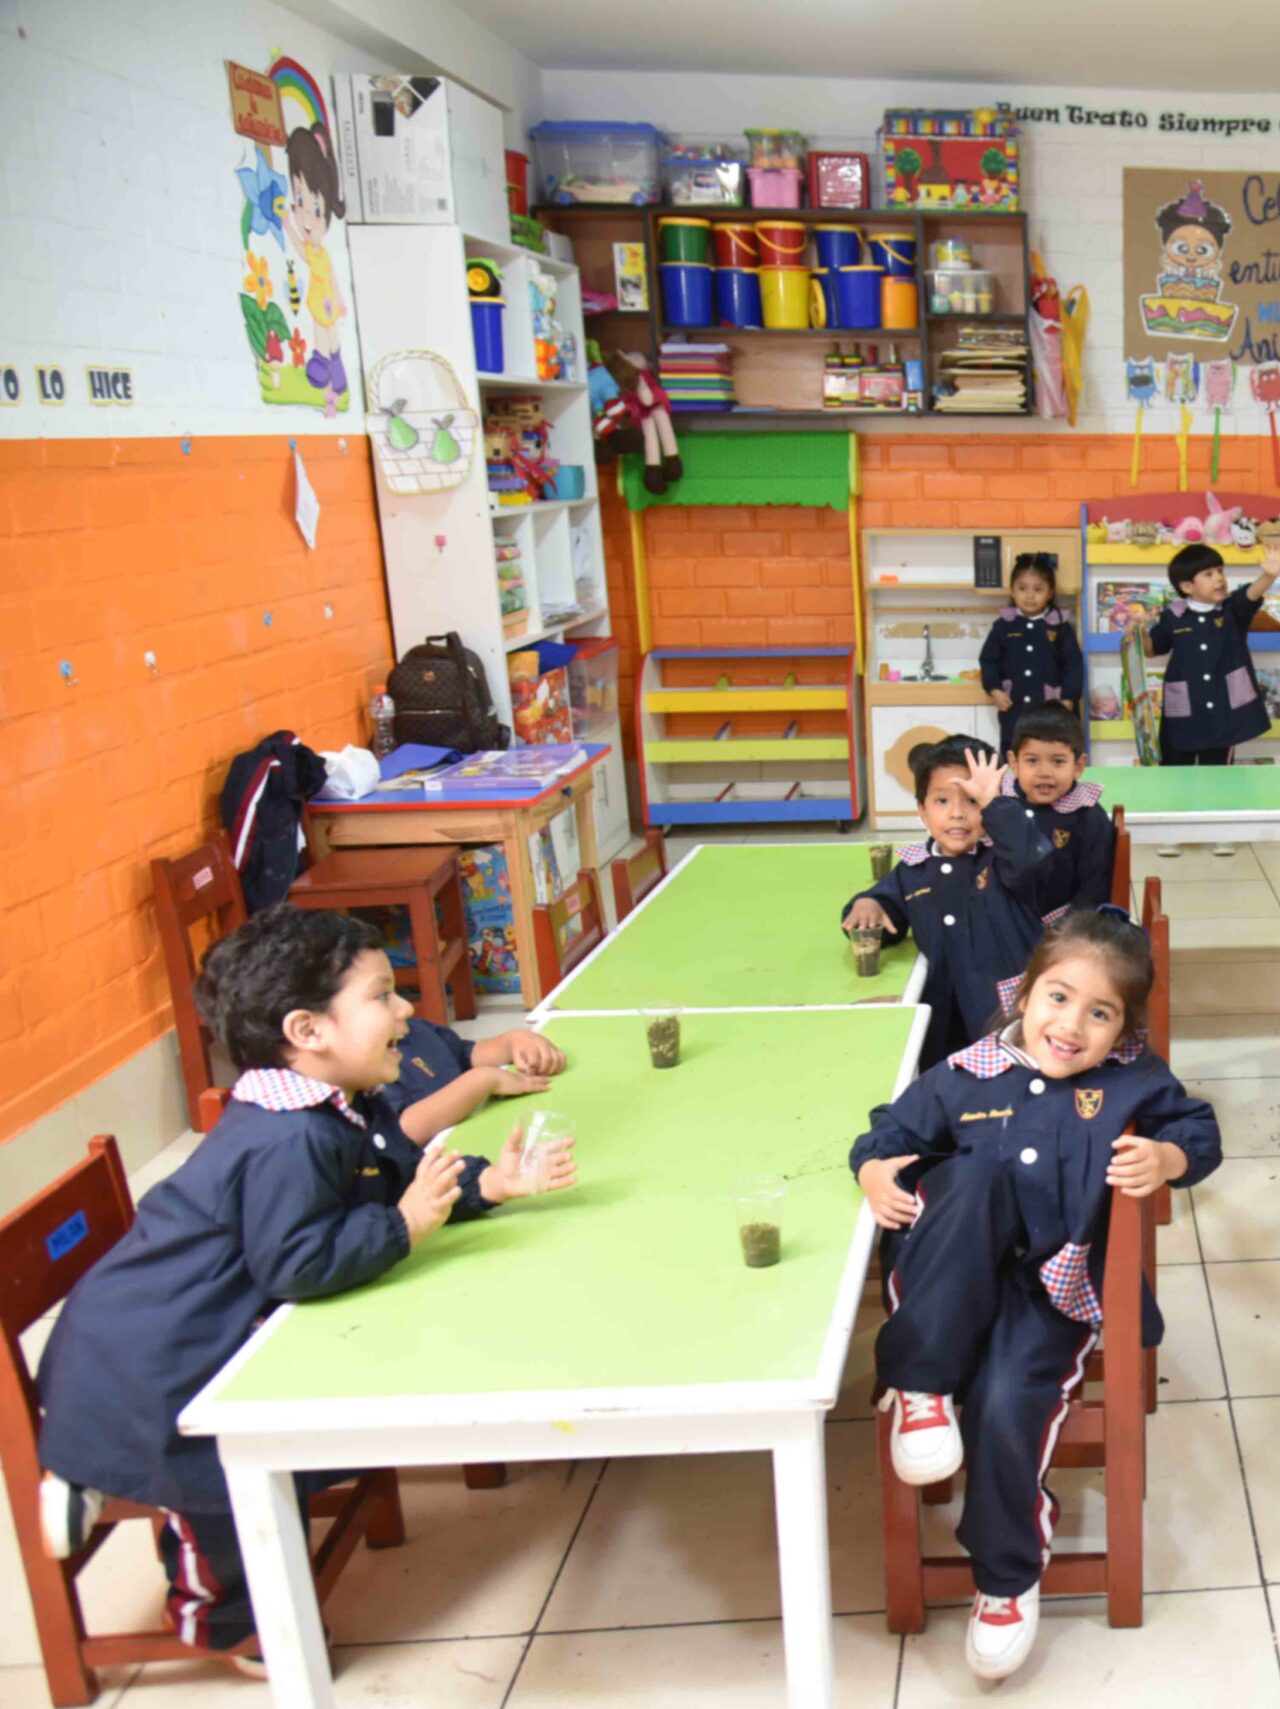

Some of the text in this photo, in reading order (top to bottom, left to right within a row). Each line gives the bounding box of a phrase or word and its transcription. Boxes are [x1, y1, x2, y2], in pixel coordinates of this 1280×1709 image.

[1065, 104, 1149, 128] Trato
[1158, 112, 1271, 137] Siempre
[0, 368, 133, 401] O LO HICE
